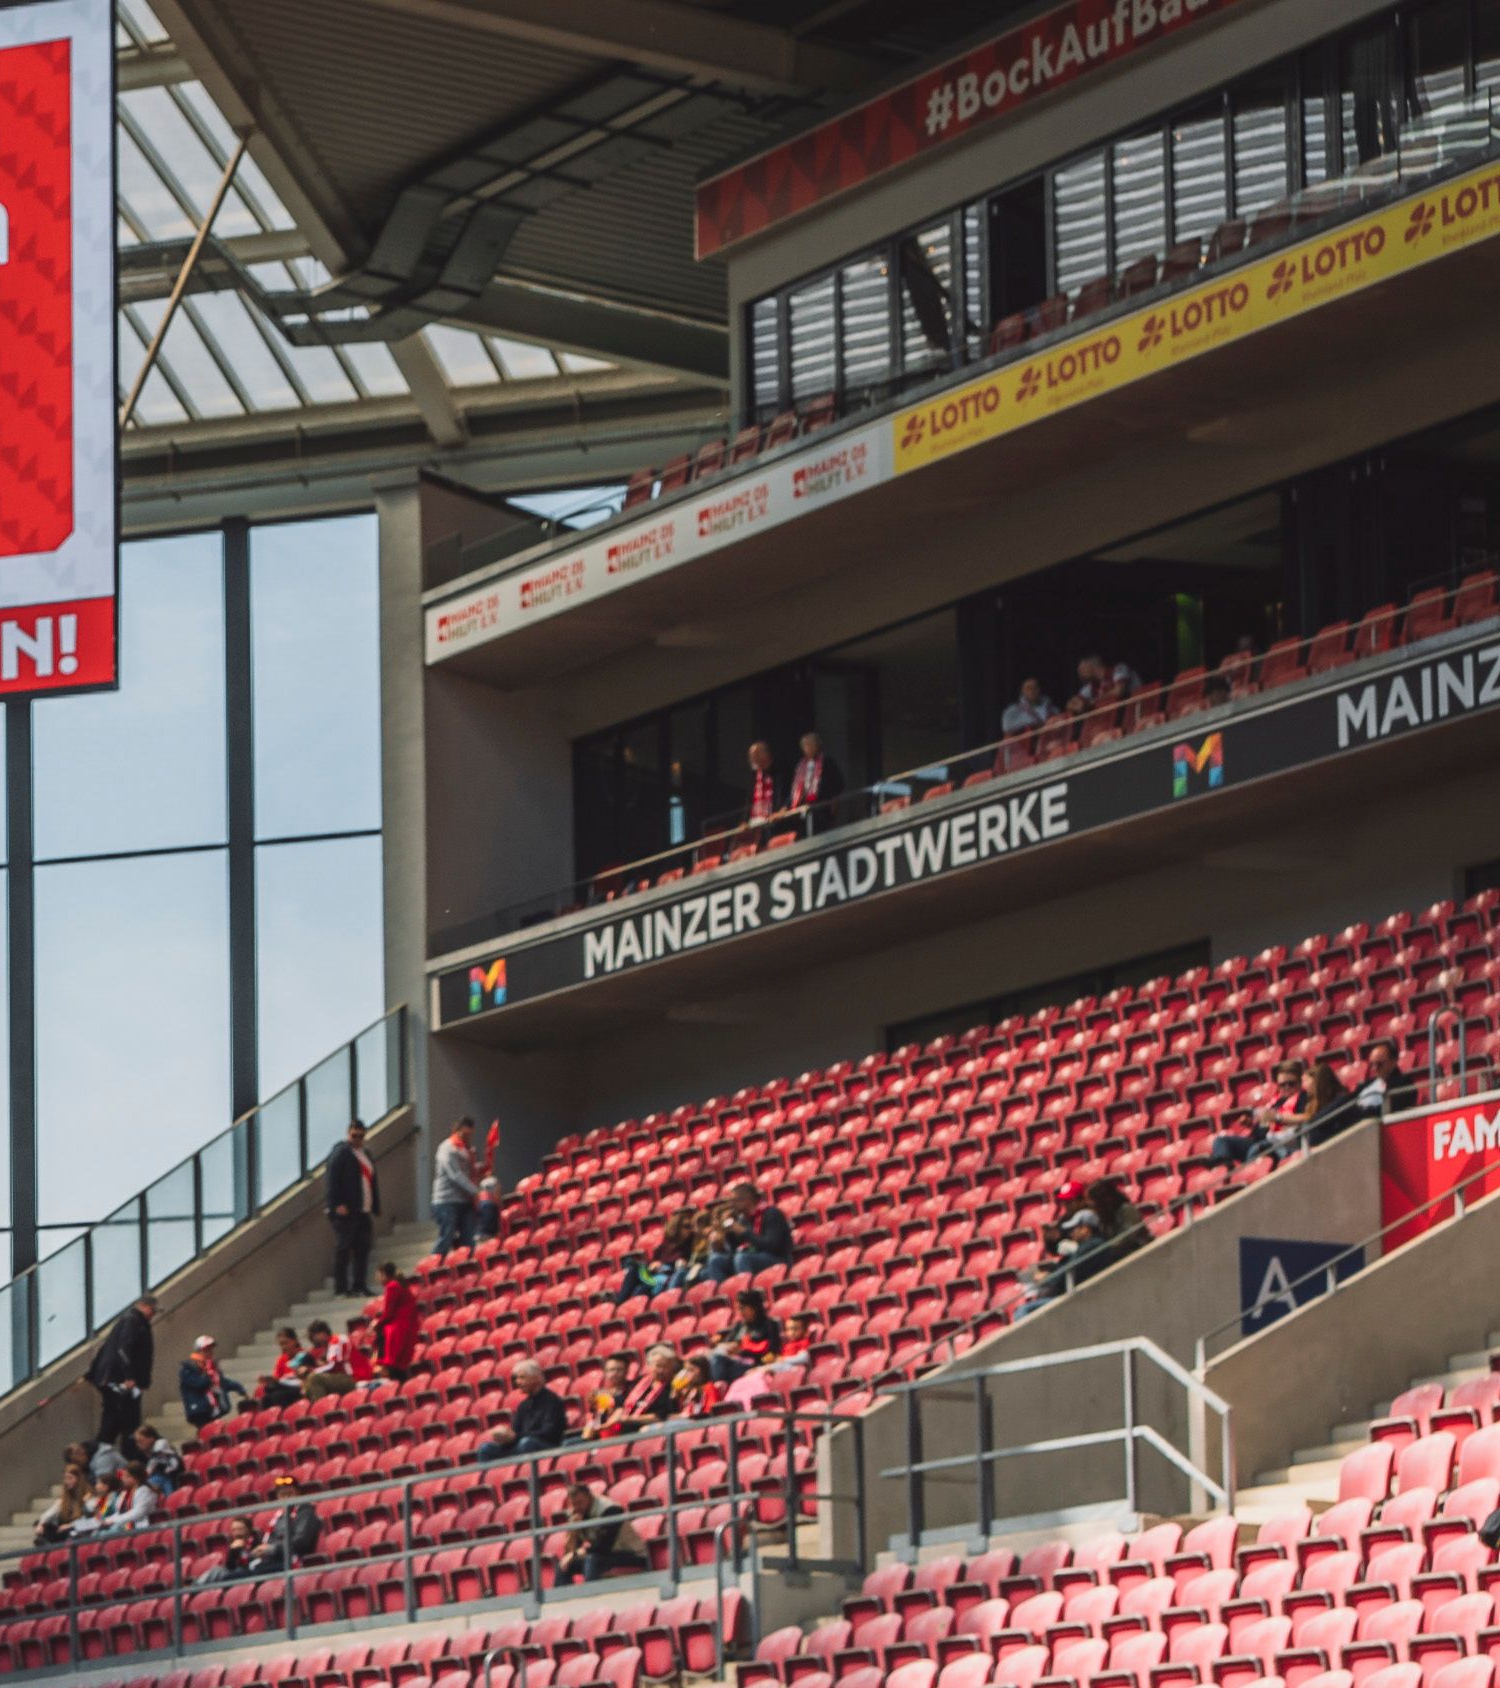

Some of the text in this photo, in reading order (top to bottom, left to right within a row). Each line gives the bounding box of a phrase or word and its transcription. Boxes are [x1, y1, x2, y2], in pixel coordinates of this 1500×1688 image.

[1302, 226, 1385, 284] LOTTO
[1170, 283, 1249, 337] LOTTO
[1047, 336, 1121, 388] LOTTO
[930, 386, 999, 436] LOTTO
[583, 895, 762, 978] MAINZER
[770, 782, 1069, 921] STADTWERKE
[1251, 1256, 1298, 1319] A
